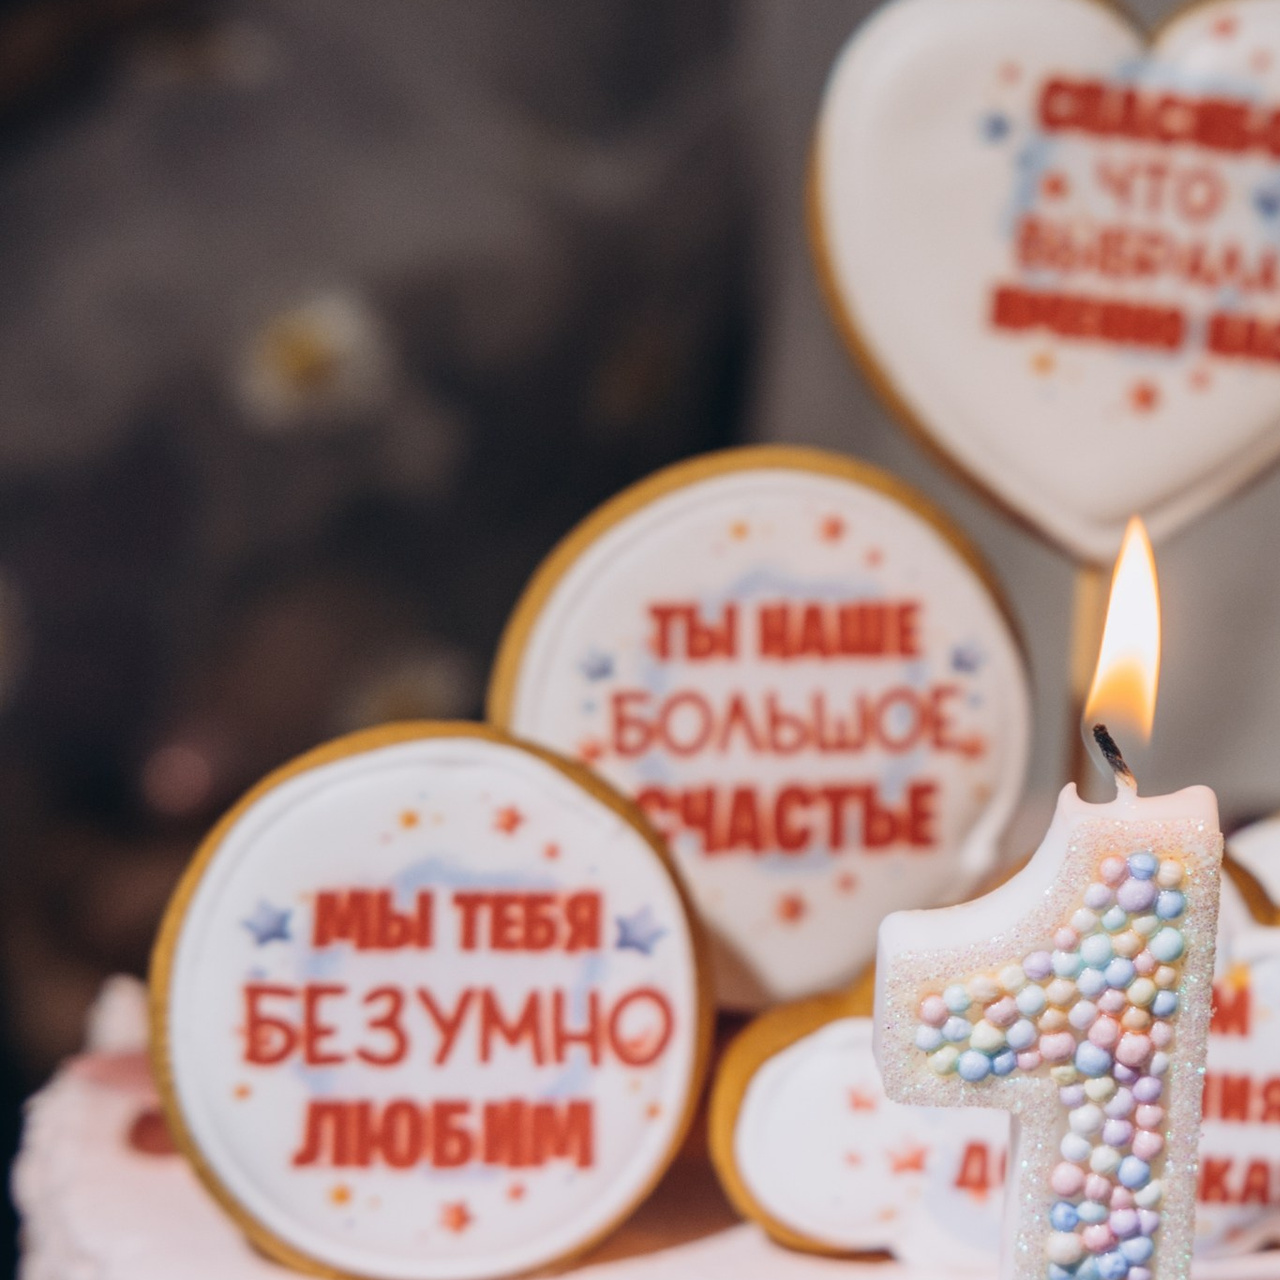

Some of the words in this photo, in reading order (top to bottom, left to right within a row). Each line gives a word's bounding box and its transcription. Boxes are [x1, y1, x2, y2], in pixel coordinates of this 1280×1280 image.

[647, 601, 740, 661] ТЫ
[755, 599, 923, 661] НАШЕ
[609, 685, 963, 758] БОЛЬШОЕ
[311, 888, 435, 952] МЫ
[451, 889, 605, 954] ТЕБЯ
[239, 982, 676, 1068] БЕЗУМНО
[291, 1097, 596, 1171] ЛЮБИМ
